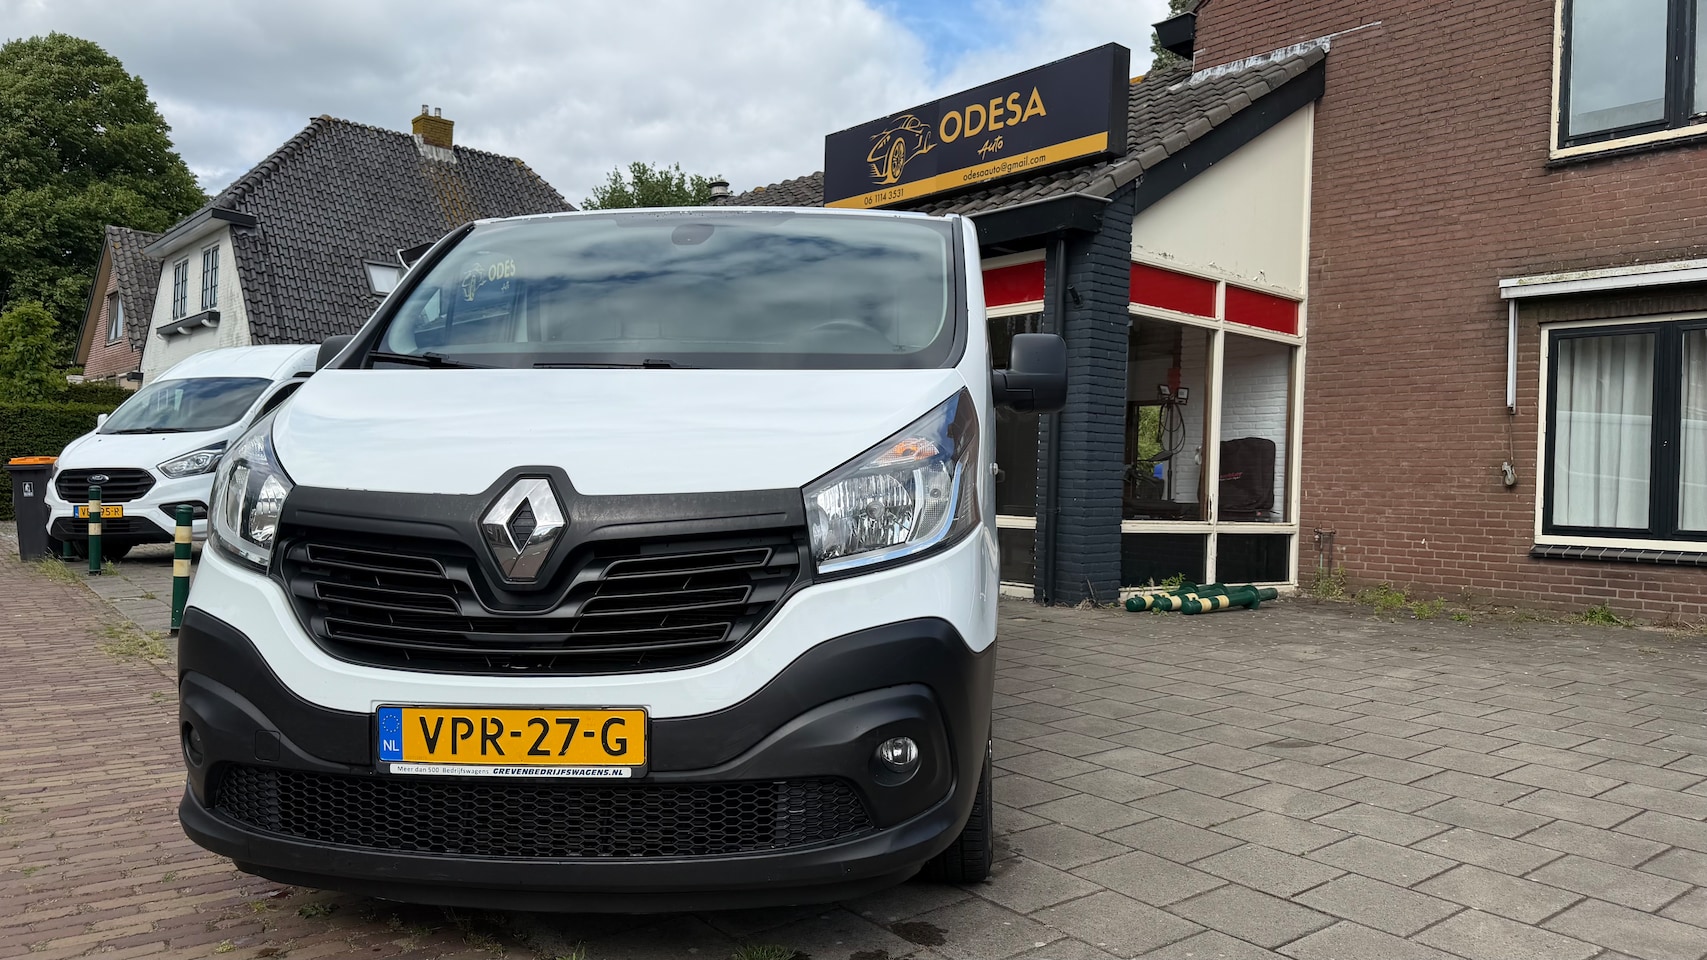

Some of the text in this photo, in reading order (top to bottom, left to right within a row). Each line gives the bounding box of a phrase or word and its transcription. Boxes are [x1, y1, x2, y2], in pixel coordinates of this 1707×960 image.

[939, 86, 1047, 143] ODESA
[977, 135, 1004, 160] Auto
[963, 154, 1046, 181] odesaauto@gmail.com
[863, 188, 904, 206] 06 1114 3531
[488, 259, 516, 282] ODES
[383, 739, 400, 752] NL
[419, 716, 628, 757] VPR-27-G
[397, 765, 414, 773] Meer
[415, 766, 427, 774] dan
[442, 767, 489, 776] Bedrijfswagens
[493, 767, 623, 776] GREVENBEDRIJFSWAGENS.NL
